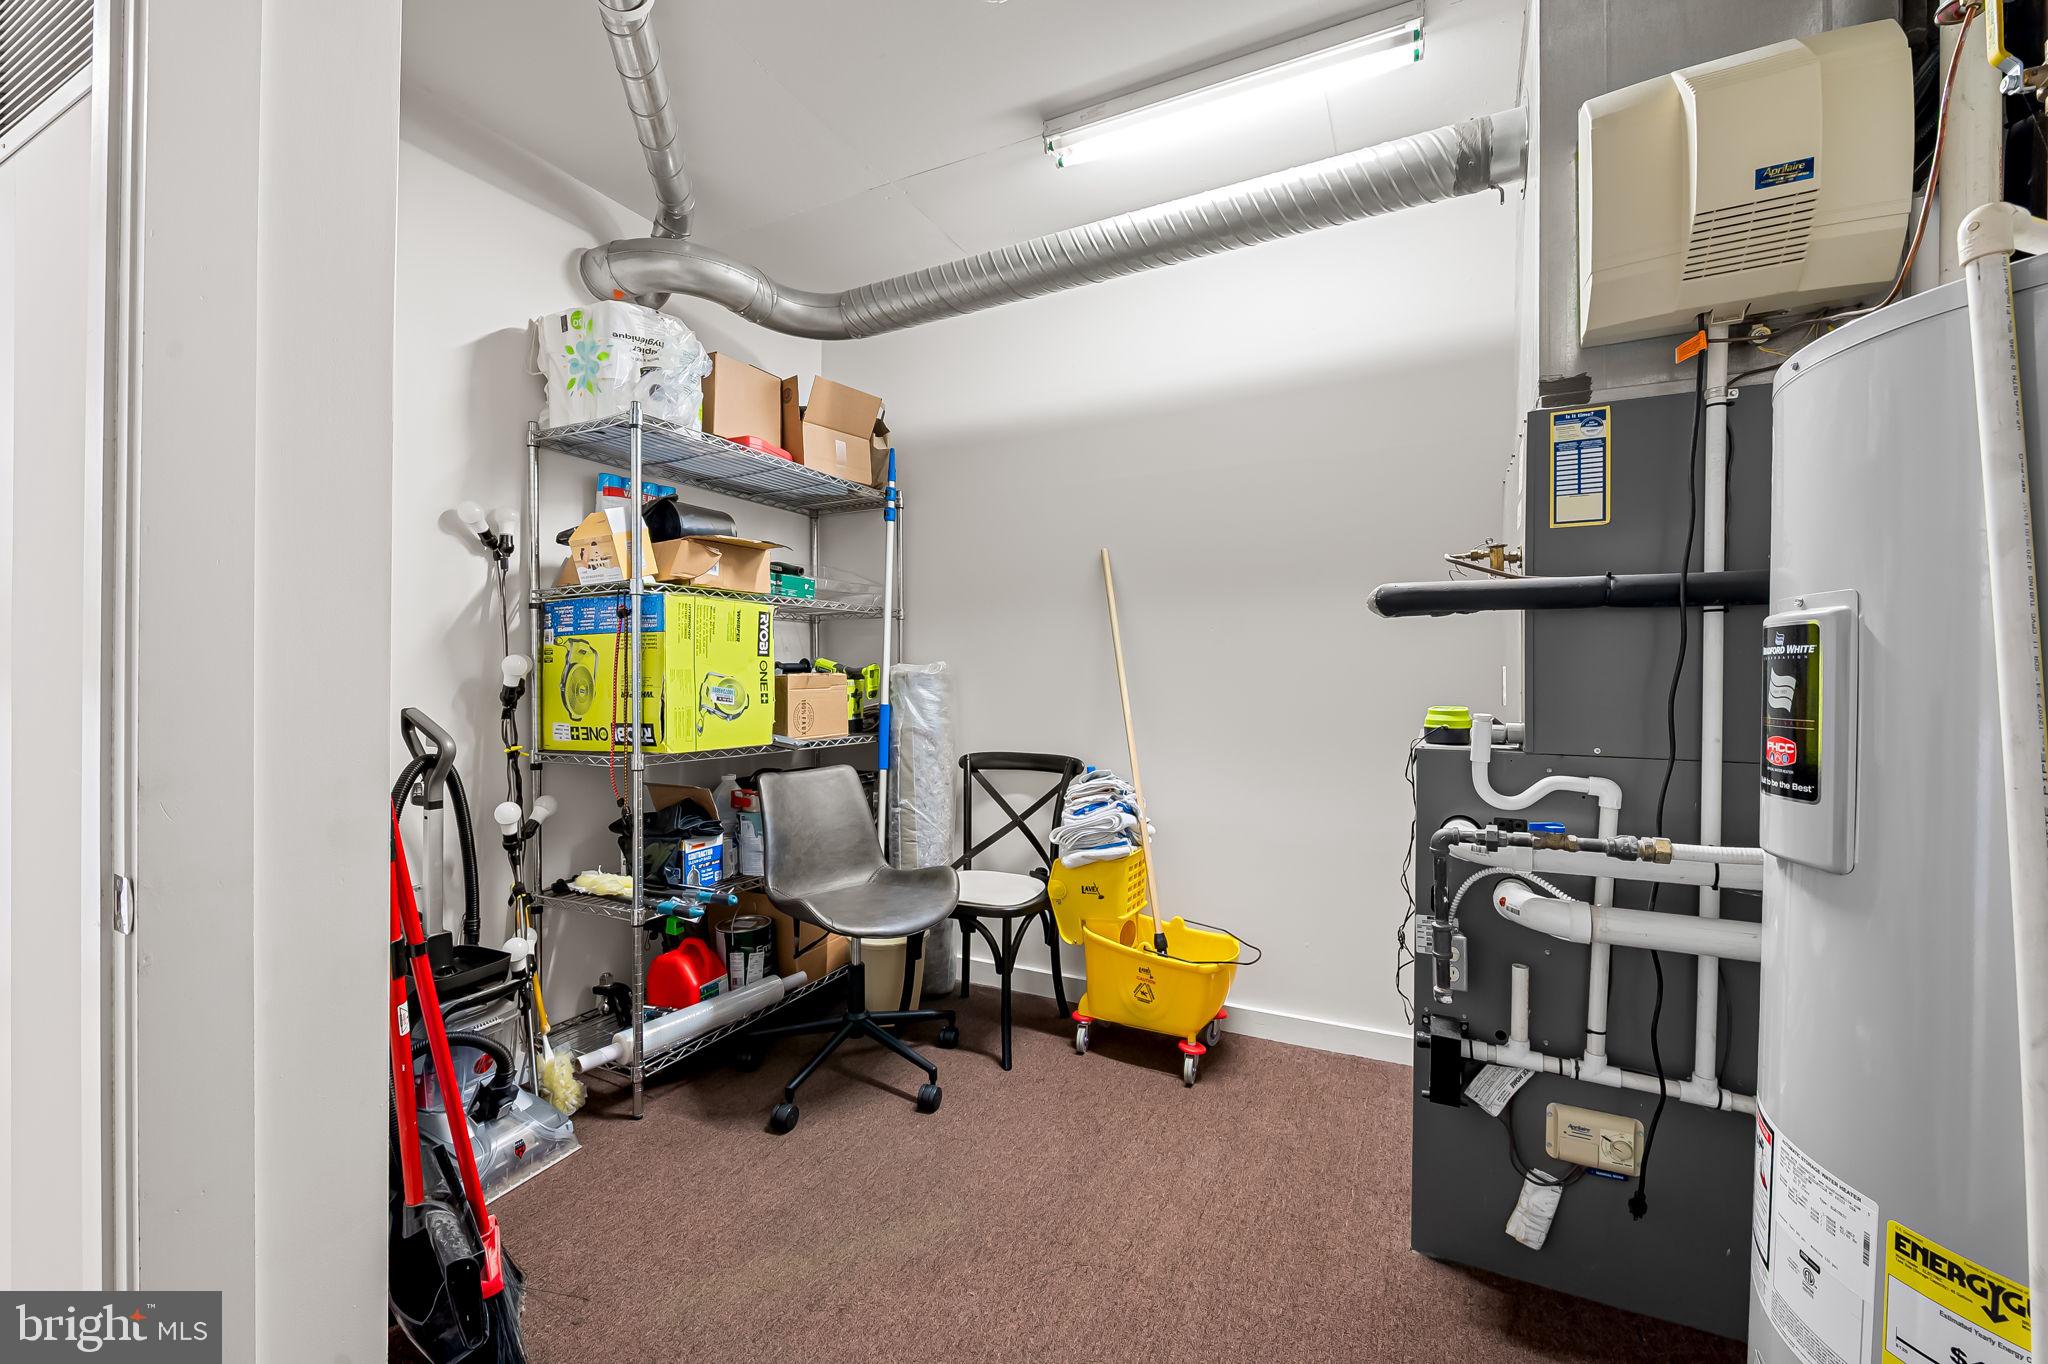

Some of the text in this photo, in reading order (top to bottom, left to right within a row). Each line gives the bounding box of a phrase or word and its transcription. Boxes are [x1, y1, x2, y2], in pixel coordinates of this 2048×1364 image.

[612, 331, 665, 349] hygiénique
[623, 489, 647, 501] VAE
[759, 613, 770, 655] RYOBI
[1786, 644, 1815, 654] WHITE
[621, 691, 654, 699] WHPR
[613, 726, 654, 743] ROB
[1767, 741, 1794, 754] PHCC
[1780, 781, 1790, 790] the
[1822, 1173, 1838, 1188] WATER
[1839, 1185, 1862, 1203] HEATER
[1940, 1309, 2024, 1361] Estimated Yearly Energy
